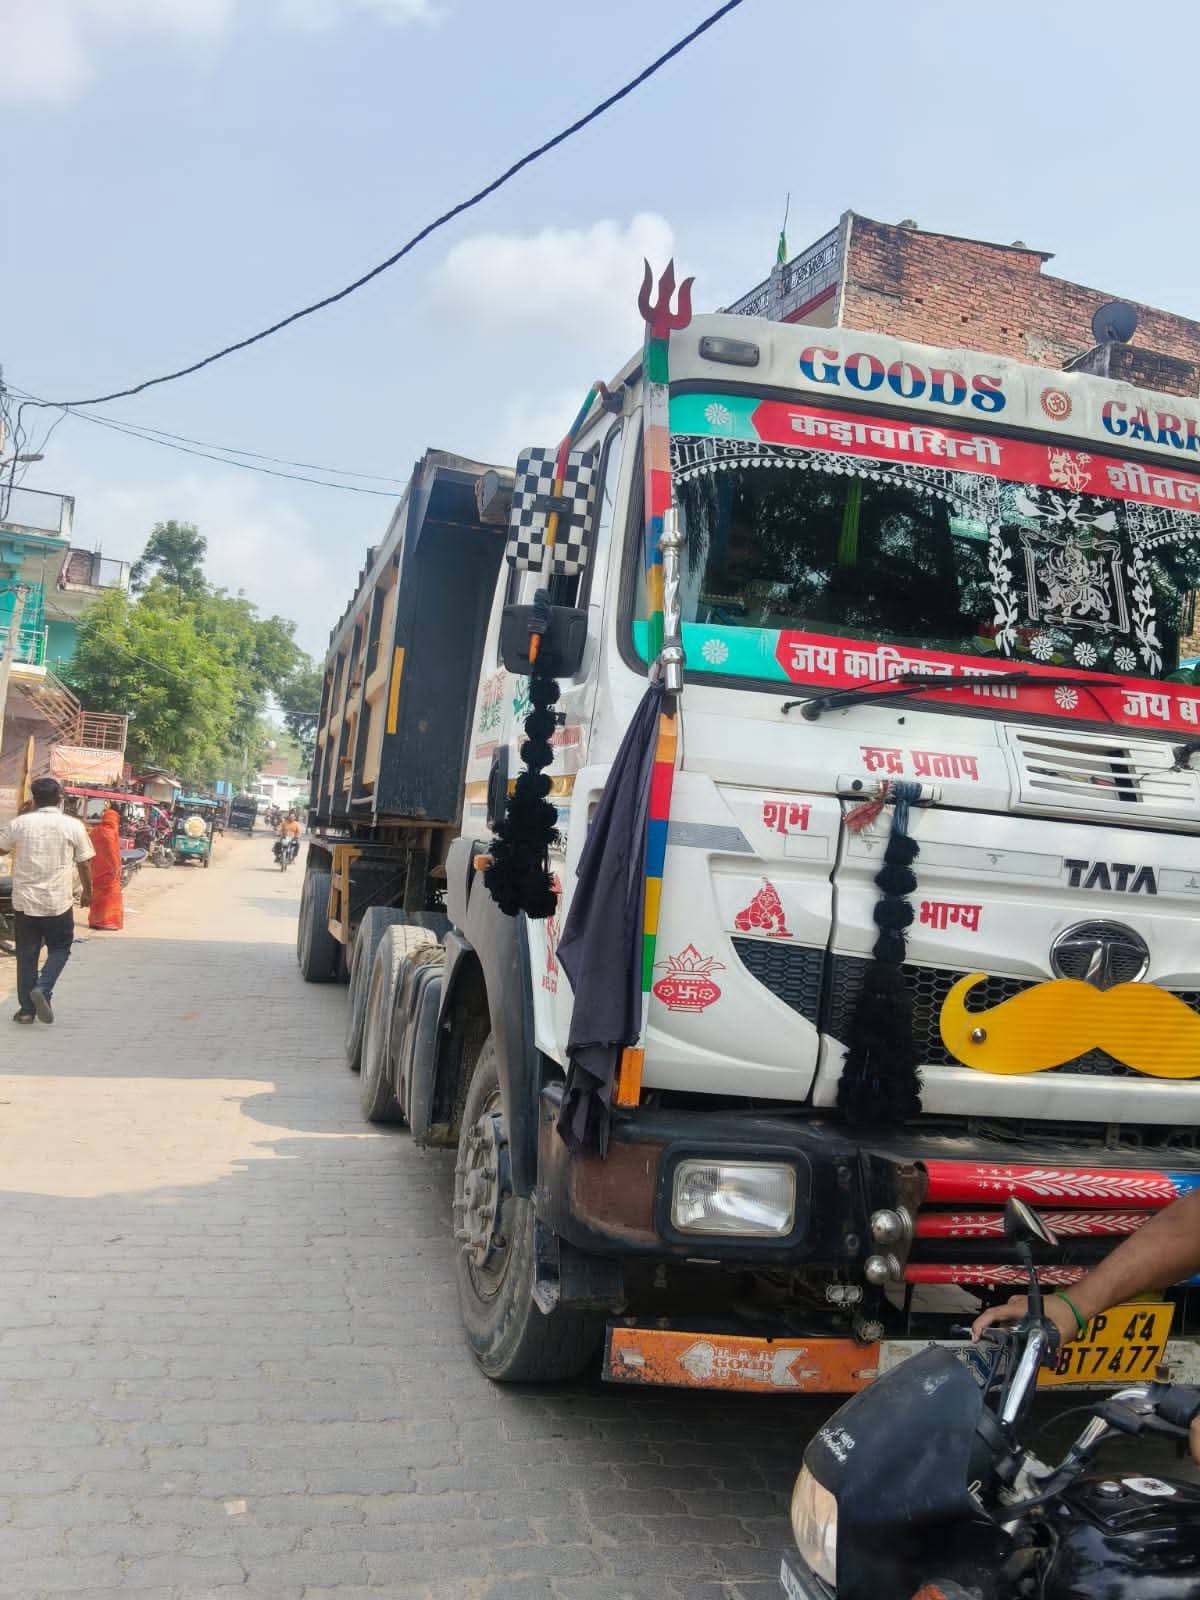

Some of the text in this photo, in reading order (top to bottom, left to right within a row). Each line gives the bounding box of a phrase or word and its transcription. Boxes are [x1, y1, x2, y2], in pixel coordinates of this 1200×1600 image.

[799, 346, 1007, 413] GOODS
[790, 643, 838, 676] जय
[1120, 689, 1171, 721] जय
[860, 746, 979, 781] रुद्र प्रताप
[763, 799, 812, 834] शुभ
[1063, 858, 1158, 896] TATA
[919, 900, 983, 932] भाग्य
[1122, 1311, 1157, 1342] 44
[1055, 1346, 1160, 1376] BT7477
